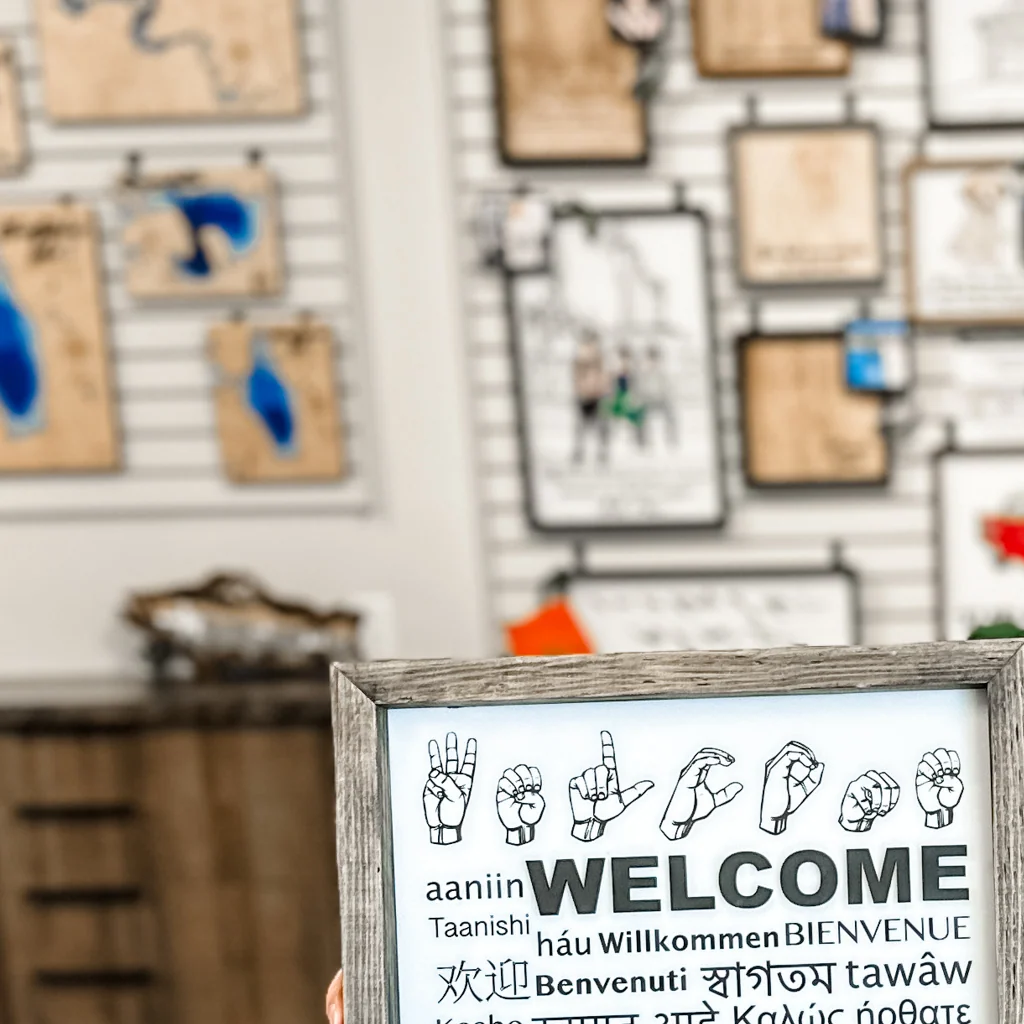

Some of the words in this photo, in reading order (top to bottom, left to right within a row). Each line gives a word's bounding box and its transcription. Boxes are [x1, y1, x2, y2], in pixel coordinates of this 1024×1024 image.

[426, 873, 523, 901] aaniin
[525, 845, 969, 917] WELCOME
[429, 914, 529, 937] Taanishi
[538, 930, 590, 956] háu
[599, 929, 778, 953] Willkommen
[786, 916, 970, 945] BIENVENUE
[437, 959, 530, 1003] 欢迎
[536, 967, 686, 996] Benvenuti
[846, 952, 972, 988] tawâw
